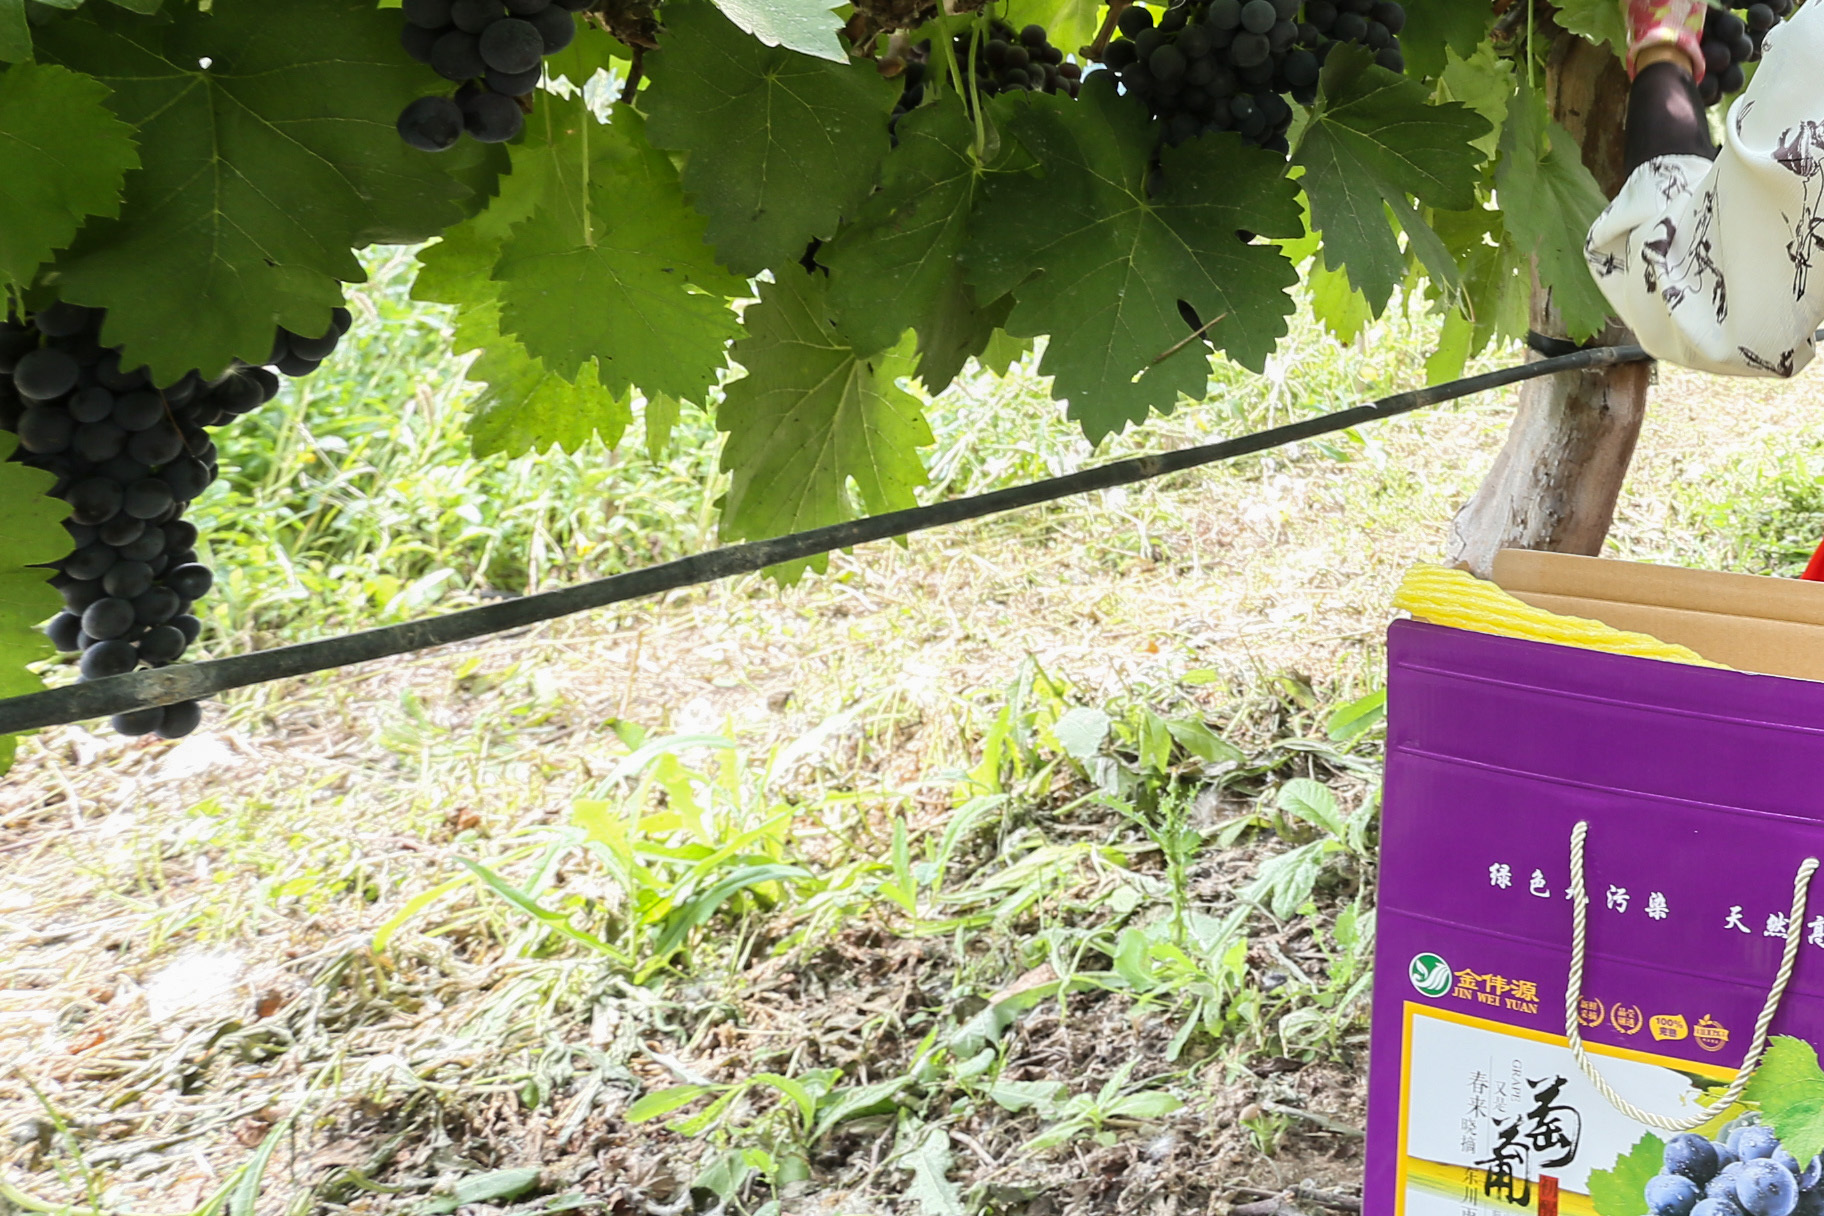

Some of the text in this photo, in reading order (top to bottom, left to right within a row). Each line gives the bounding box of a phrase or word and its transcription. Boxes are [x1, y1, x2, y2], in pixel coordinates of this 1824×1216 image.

[1452, 986, 1538, 1014] JIN WEI YUAN
[1453, 968, 1540, 1002] 金伟源
[1656, 1017, 1683, 1029] 100%
[1511, 1059, 1523, 1102] GRAPE
